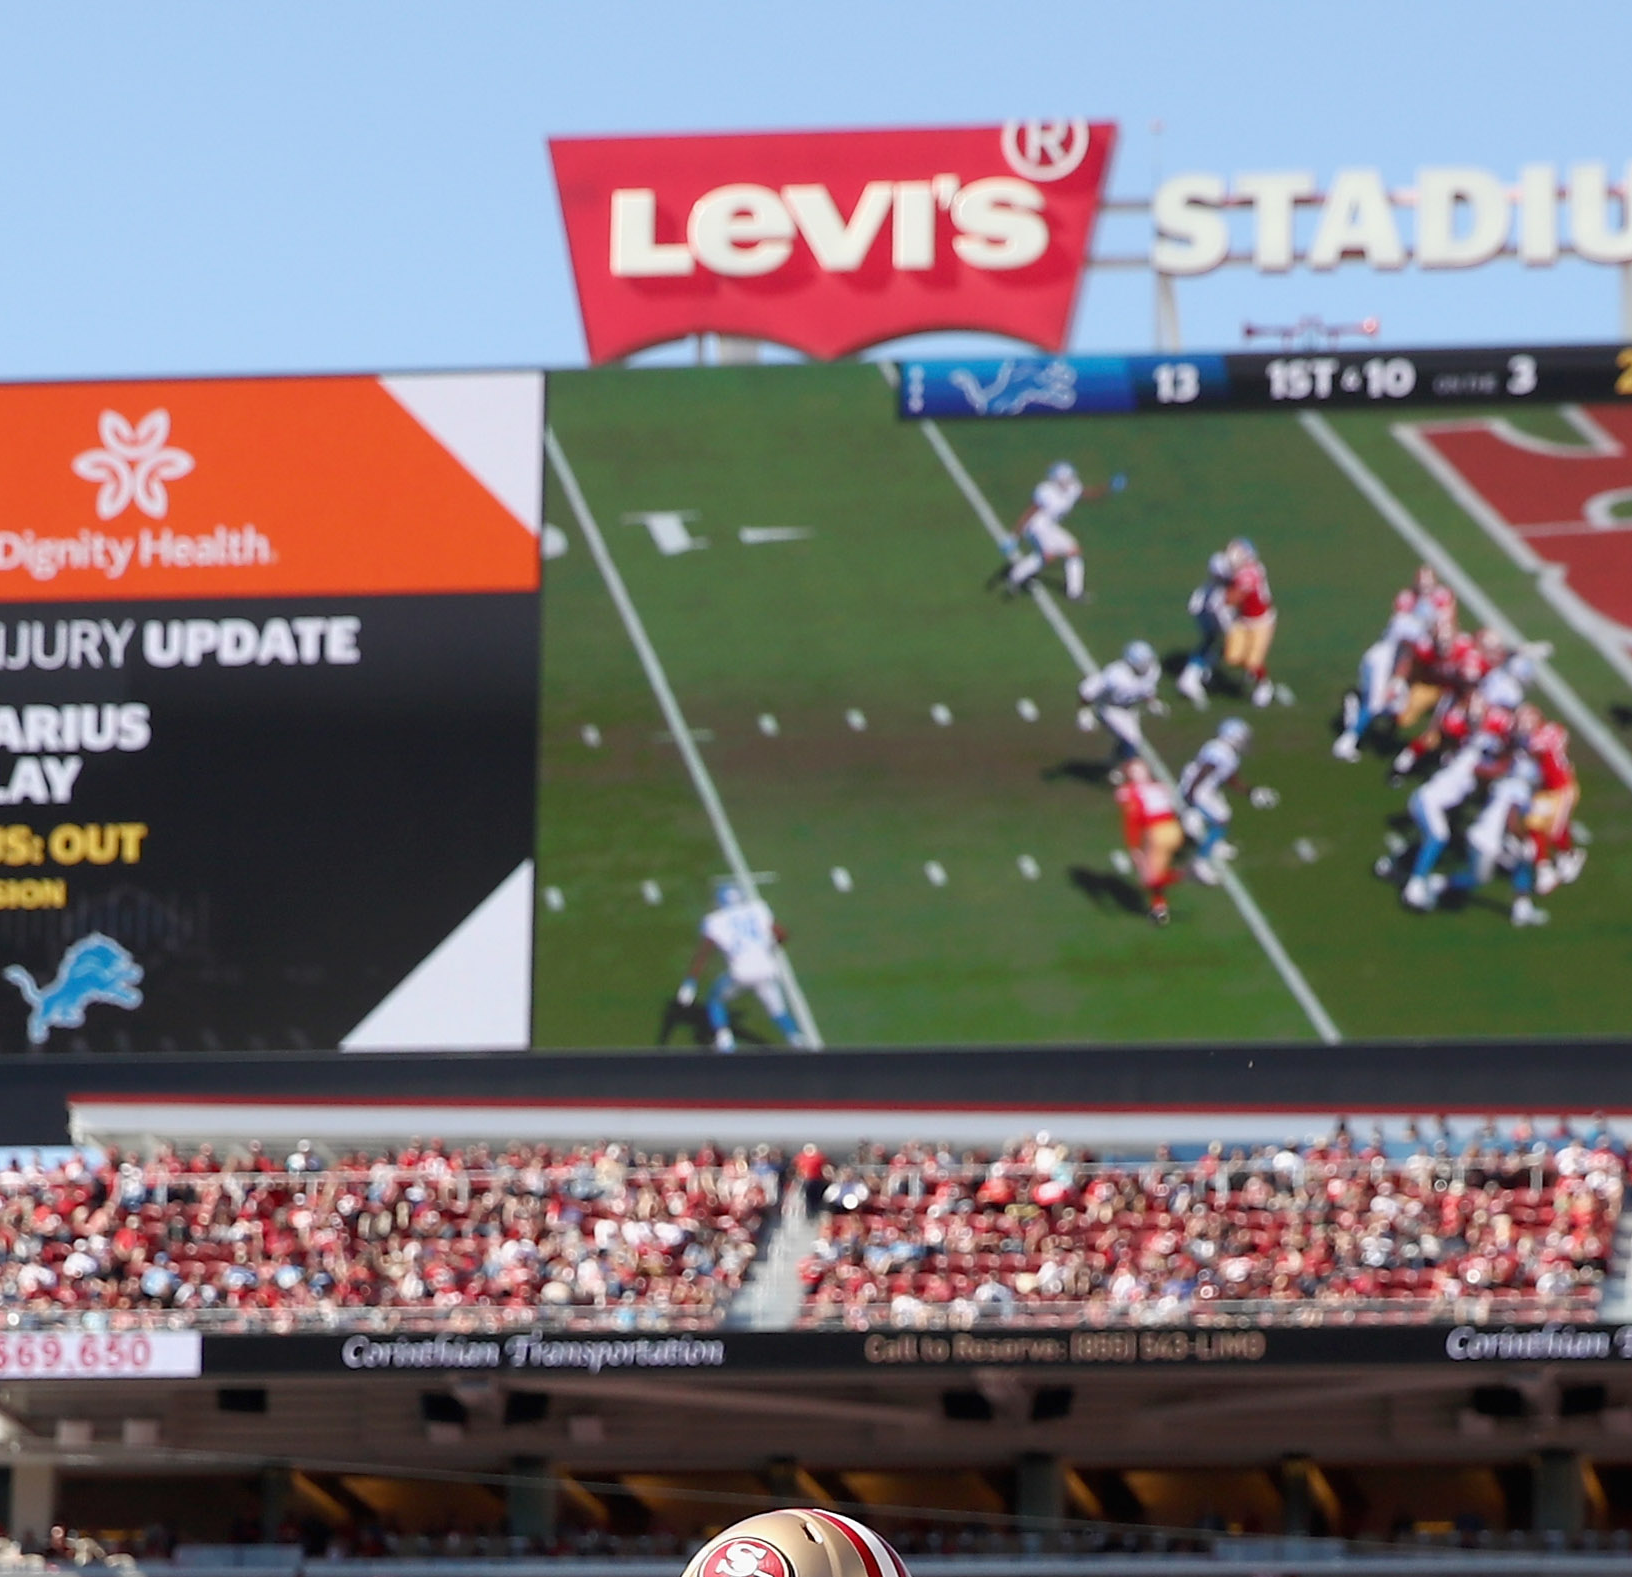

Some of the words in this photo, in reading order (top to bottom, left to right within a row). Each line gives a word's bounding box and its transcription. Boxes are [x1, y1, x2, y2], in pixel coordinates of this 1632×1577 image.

[1153, 362, 1200, 402] 13
[1267, 355, 1339, 400] 1ST
[1367, 356, 1417, 398] 10
[144, 617, 362, 666] UPDATE
[48, 822, 149, 865] OUT
[341, 1333, 501, 1369] Corinthian
[505, 1328, 725, 1374] Transportation
